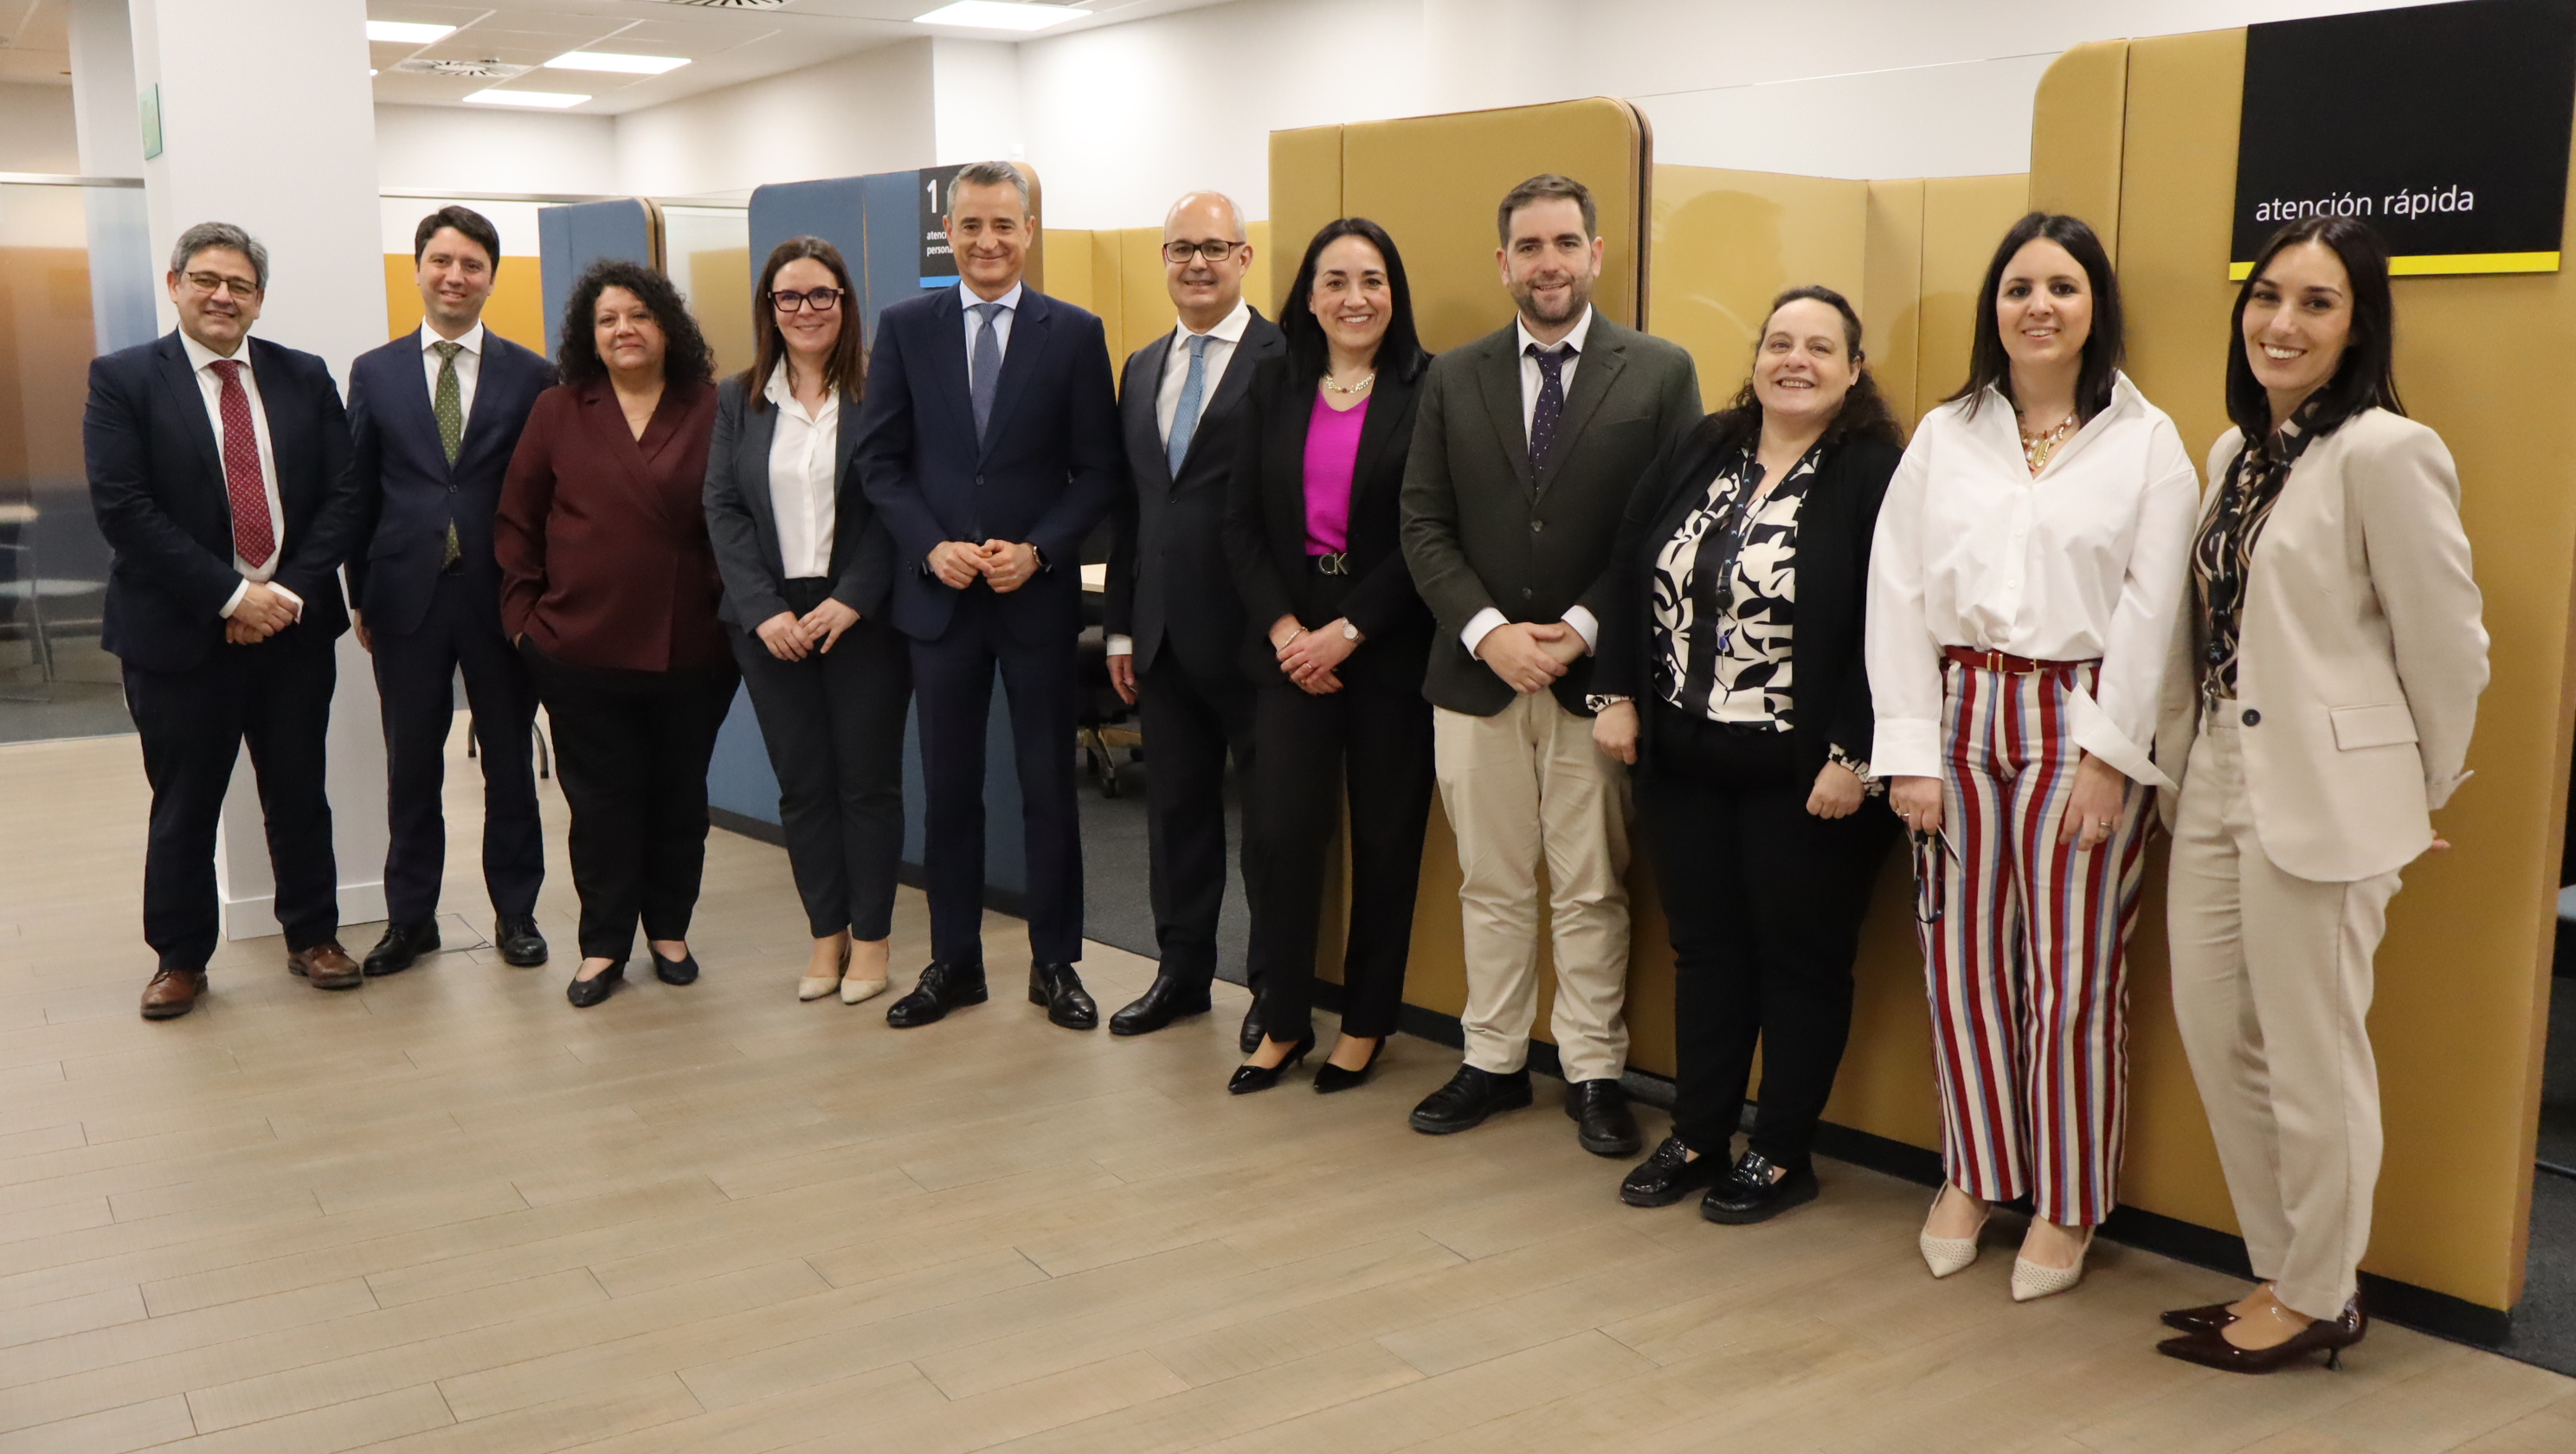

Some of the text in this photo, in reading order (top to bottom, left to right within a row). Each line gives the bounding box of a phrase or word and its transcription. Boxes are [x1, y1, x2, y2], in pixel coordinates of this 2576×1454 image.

[926, 178, 937, 214] 1
[2255, 183, 2474, 222] atención rápida
[926, 230, 947, 241] atenci
[926, 245, 954, 257] persona
